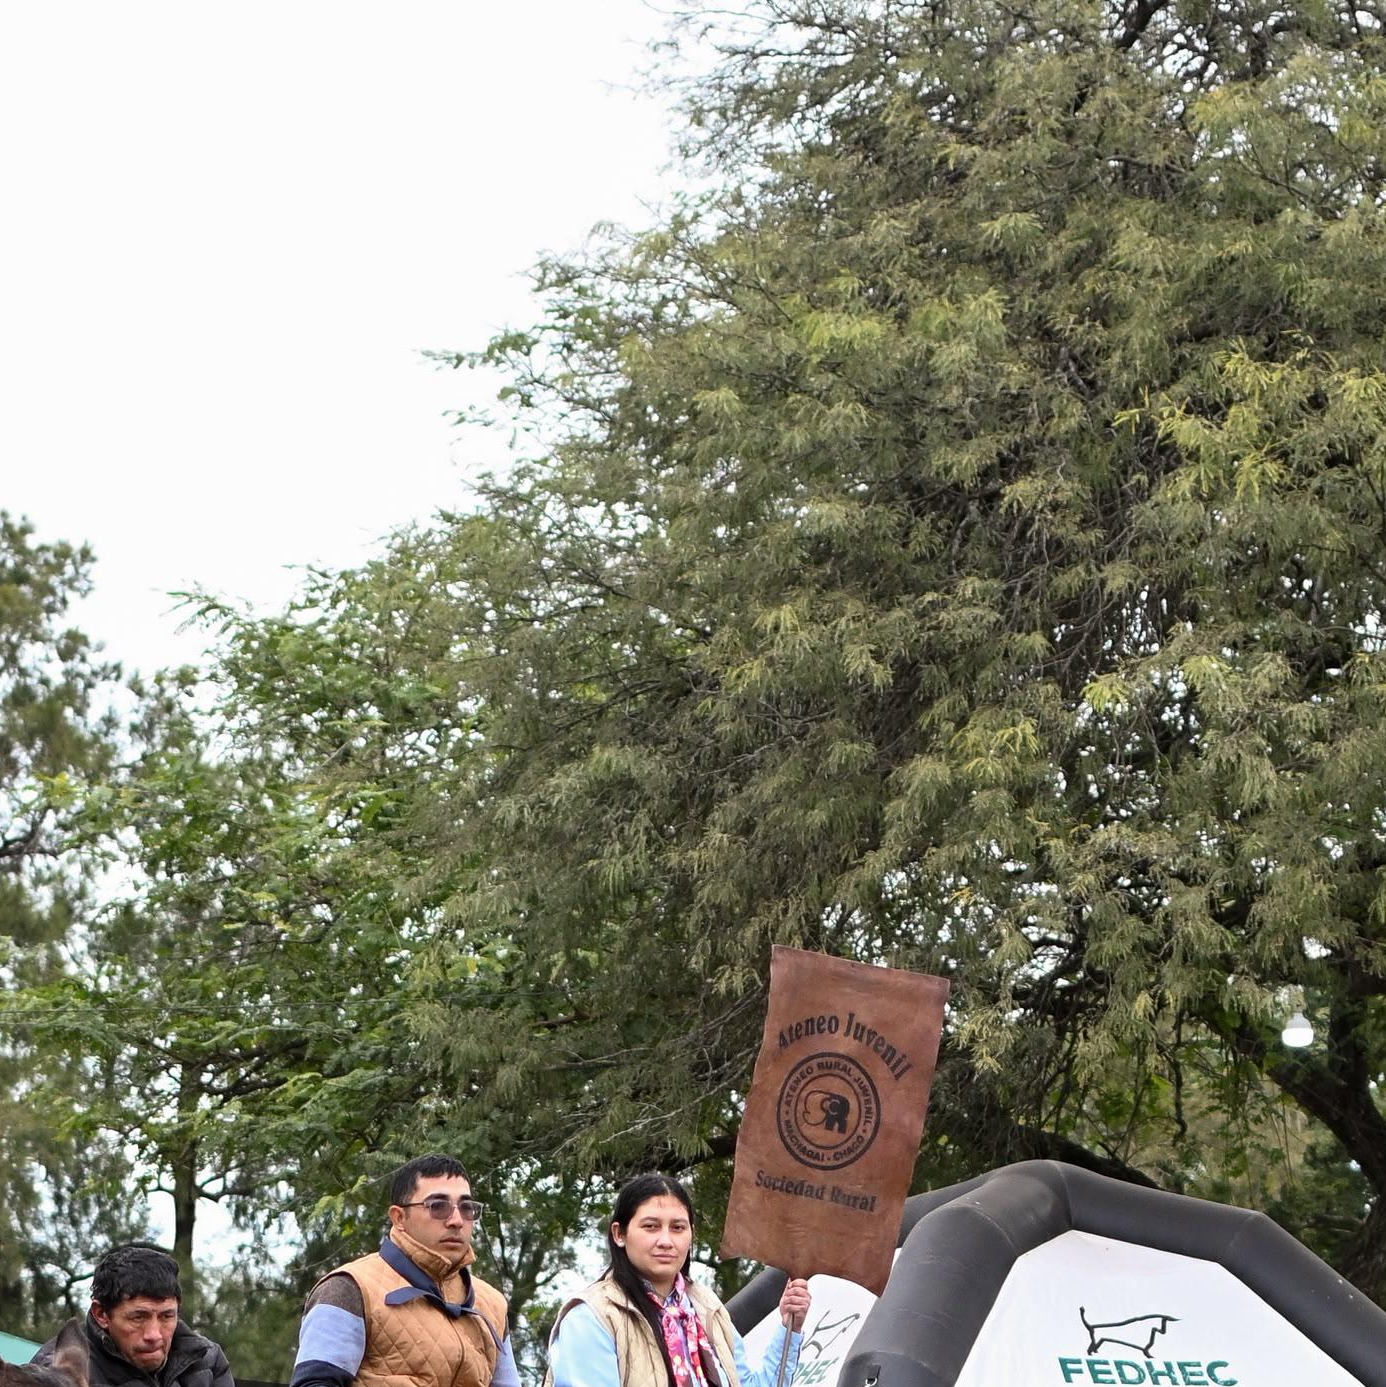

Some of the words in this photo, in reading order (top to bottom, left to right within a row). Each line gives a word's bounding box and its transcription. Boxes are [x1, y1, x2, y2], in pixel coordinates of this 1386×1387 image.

[779, 1014, 839, 1050] Ateneo
[844, 1012, 913, 1082] Juvenil
[785, 1066, 814, 1107] ATENEO
[817, 1061, 853, 1077] RURAL
[854, 1077, 873, 1126] JUVENIL
[785, 1120, 824, 1161] MACHAGAI
[834, 1135, 864, 1161] CHACO
[755, 1170, 826, 1201] Sociedad
[831, 1186, 877, 1212] Rural
[1058, 1357, 1238, 1387] FEDHEC
